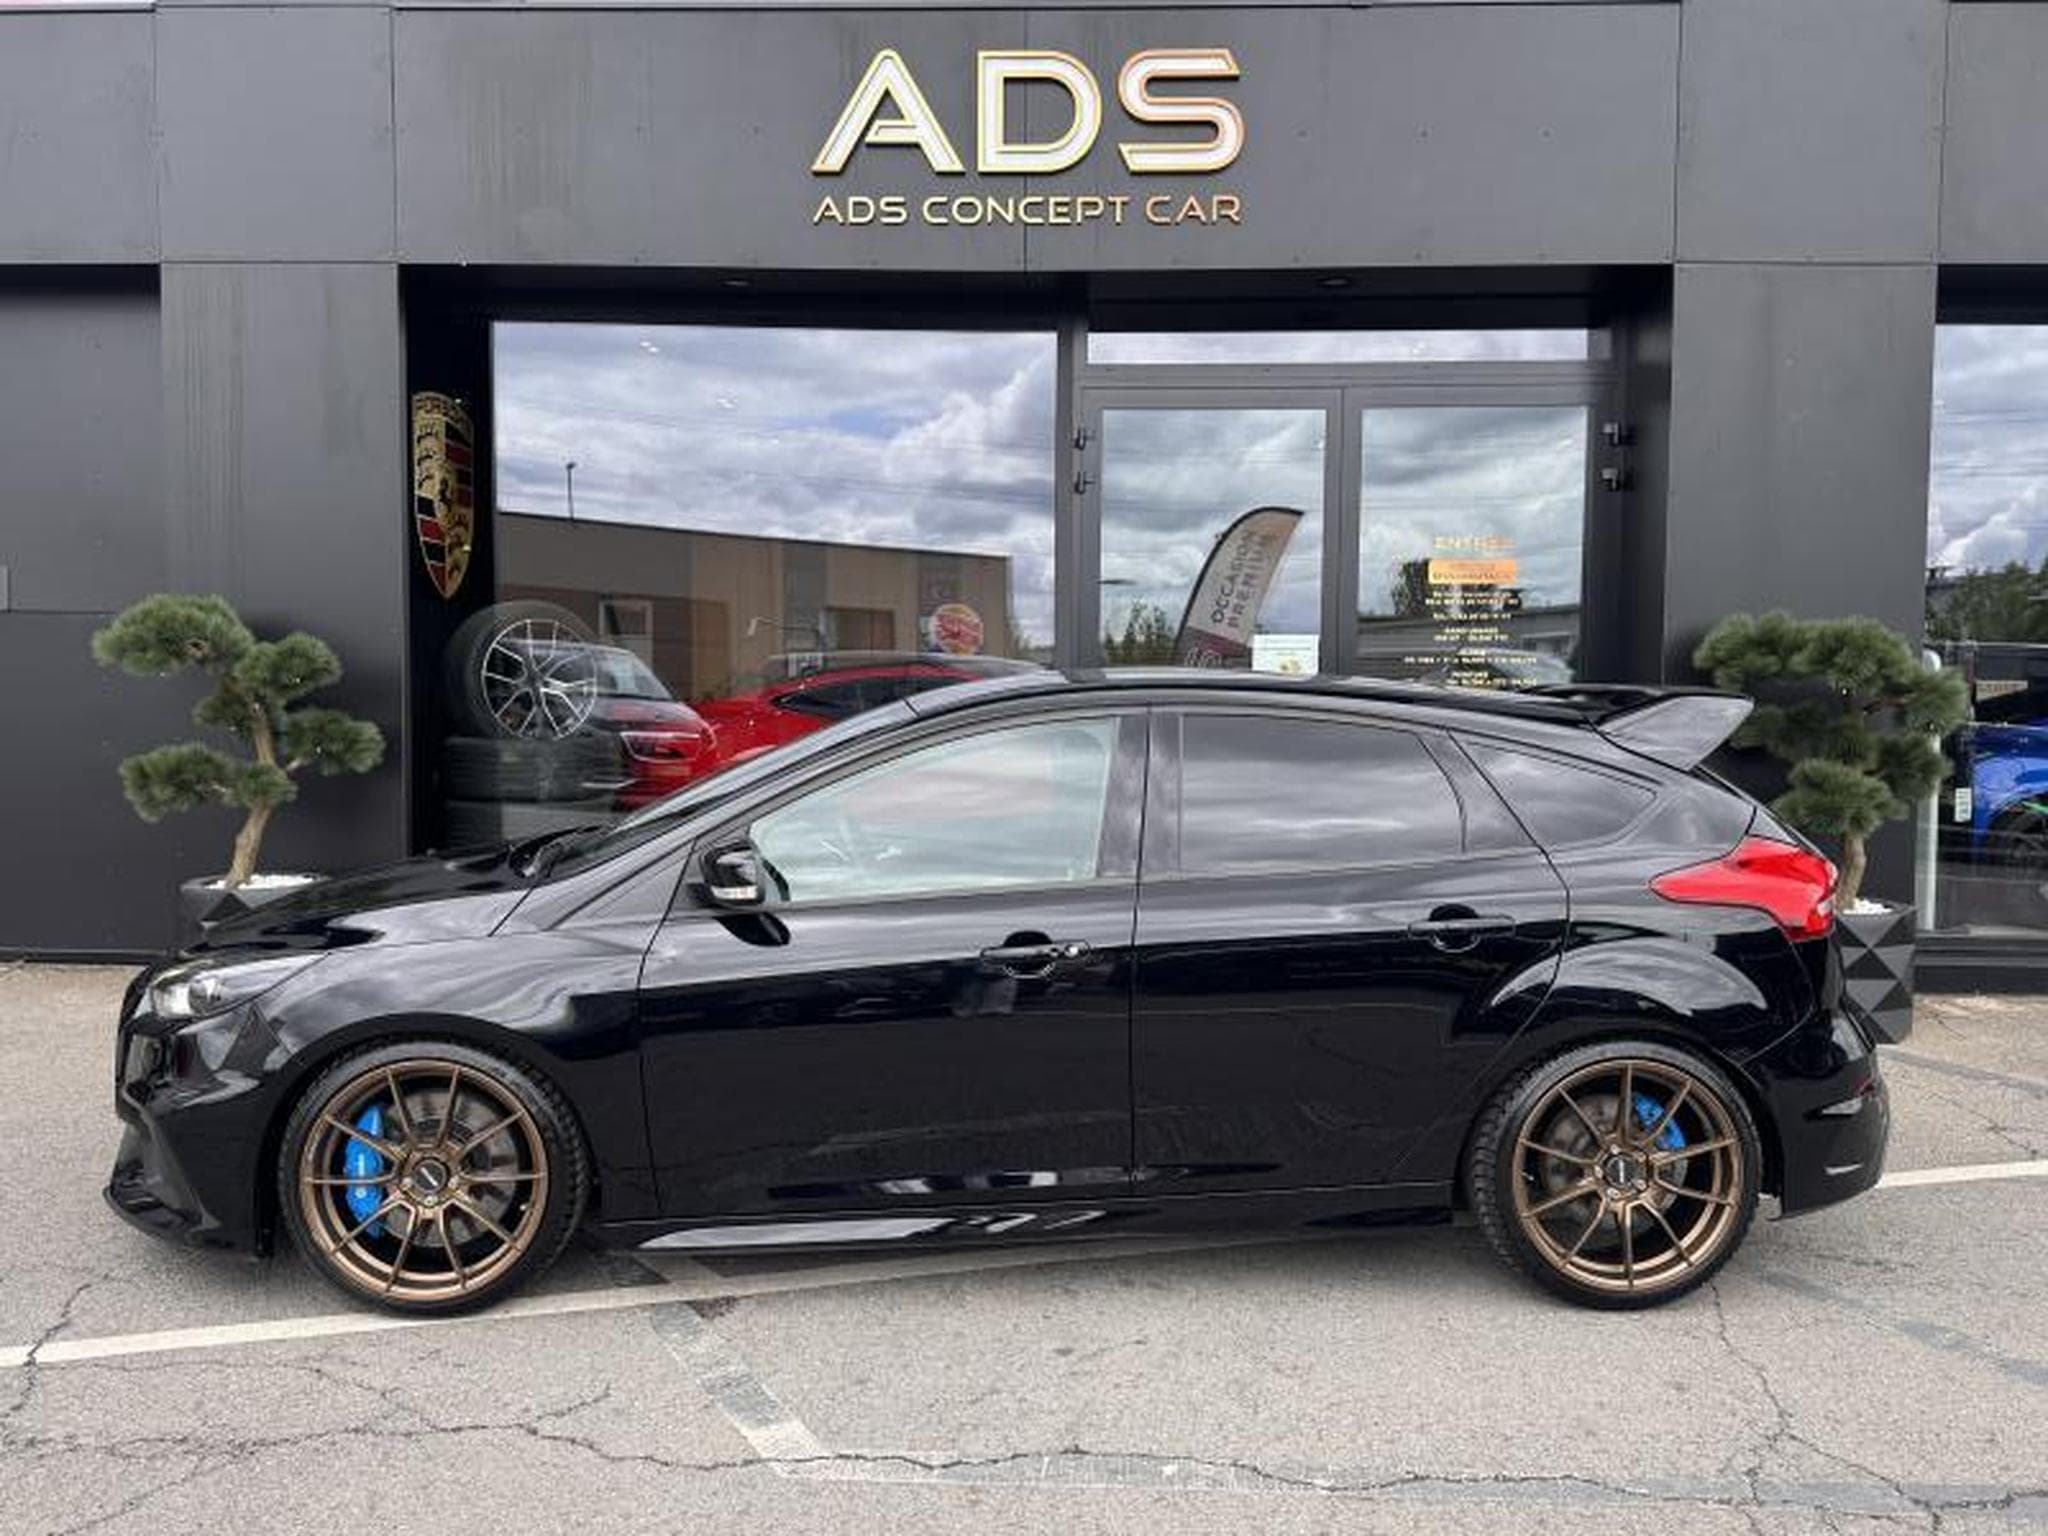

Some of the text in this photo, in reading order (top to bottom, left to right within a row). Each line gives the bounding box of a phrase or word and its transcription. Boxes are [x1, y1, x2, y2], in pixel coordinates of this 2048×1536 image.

[811, 47, 1246, 174] ADS
[813, 195, 1241, 225] ADS CONCEPT CAR
[1210, 529, 1257, 624] OCCASION
